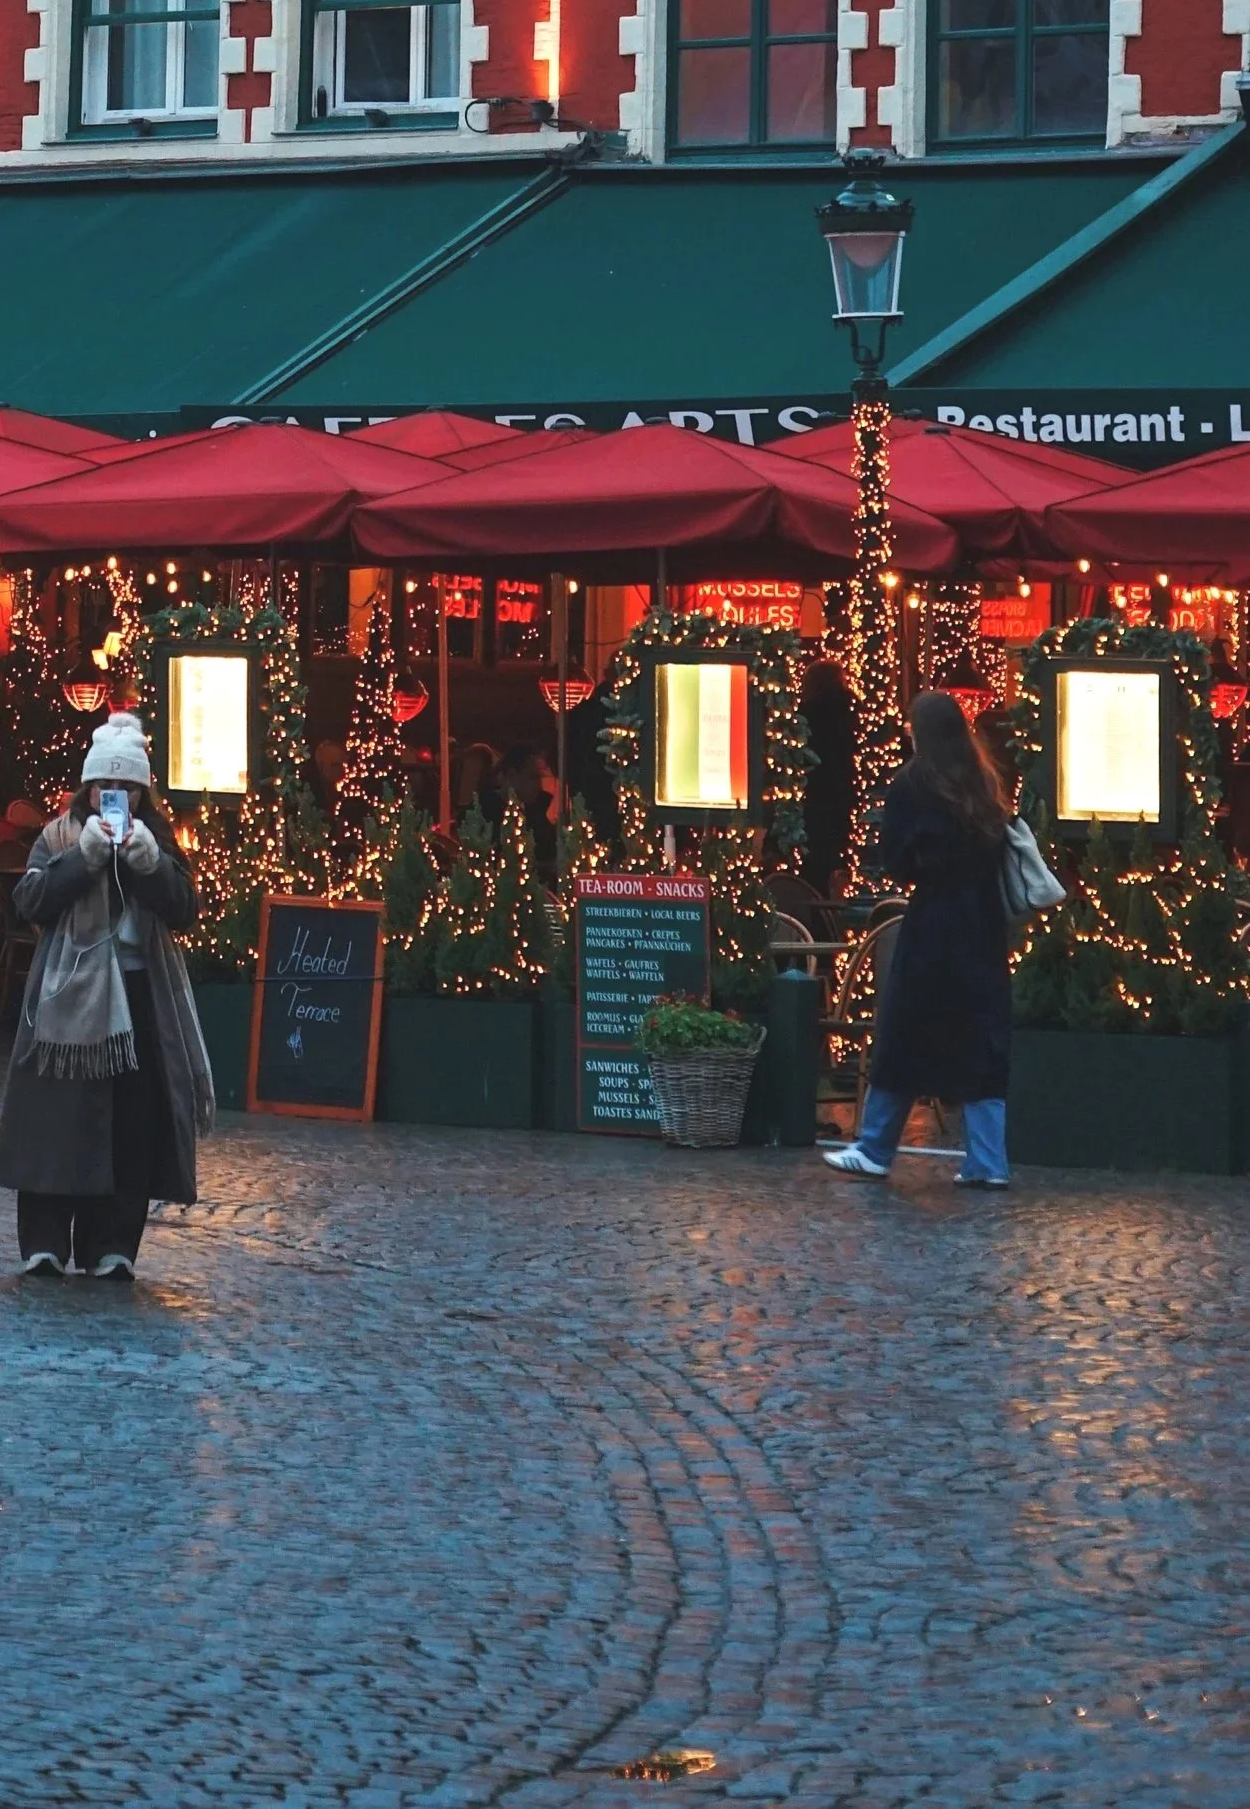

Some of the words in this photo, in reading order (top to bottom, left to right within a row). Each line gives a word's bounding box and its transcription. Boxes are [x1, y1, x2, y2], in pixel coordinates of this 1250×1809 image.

[937, 405, 1185, 443] Restaurant
[579, 879, 643, 896] TEA-ROOM
[656, 882, 705, 898] SNACKS
[585, 907, 642, 919] STREEKBIEREN
[651, 911, 675, 921] LOCAL
[676, 912, 701, 922] BEERS
[585, 927, 643, 939] PANNEKOEKEN
[585, 938, 626, 949] PANCAKES
[277, 926, 352, 975] Heated
[586, 958, 616, 968] WAFELS
[624, 960, 659, 970] GAUFRES
[586, 969, 621, 980] WAFFELS
[628, 971, 664, 982] WAFFELN
[280, 982, 341, 1023] Terrace
[586, 992, 628, 1003] PATISSERIE
[587, 1023, 625, 1034] ICECREAM
[586, 1060, 639, 1074] SANWICHES
[599, 1077, 629, 1089] SOUPS
[598, 1091, 640, 1104] MUSSELS
[593, 1106, 632, 1119] TOASTES
